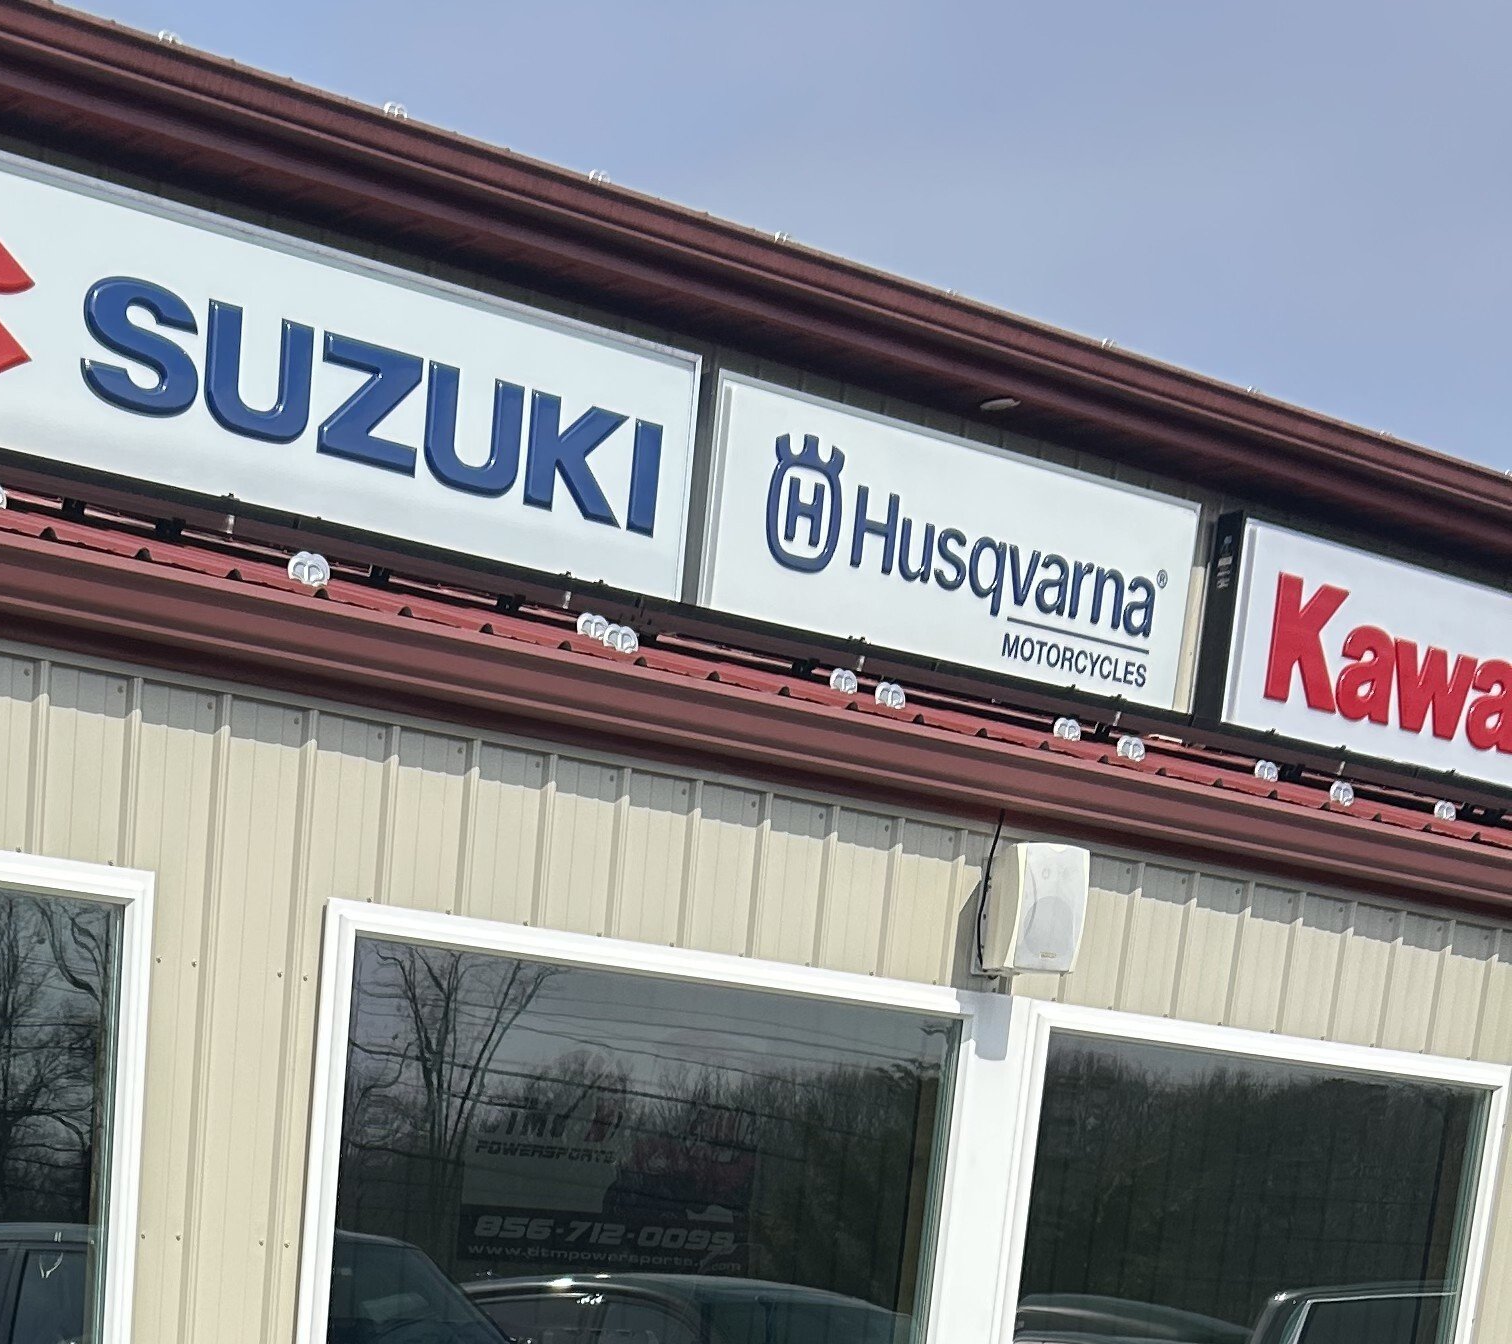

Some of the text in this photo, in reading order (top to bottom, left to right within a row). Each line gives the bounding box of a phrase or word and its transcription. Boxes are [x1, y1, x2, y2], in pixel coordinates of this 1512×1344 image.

[80, 275, 664, 538] SUZUKI
[849, 484, 1156, 638] Husqvarna
[1000, 632, 1148, 688] MOTORCYCLES
[1263, 571, 1512, 755] Kawa
